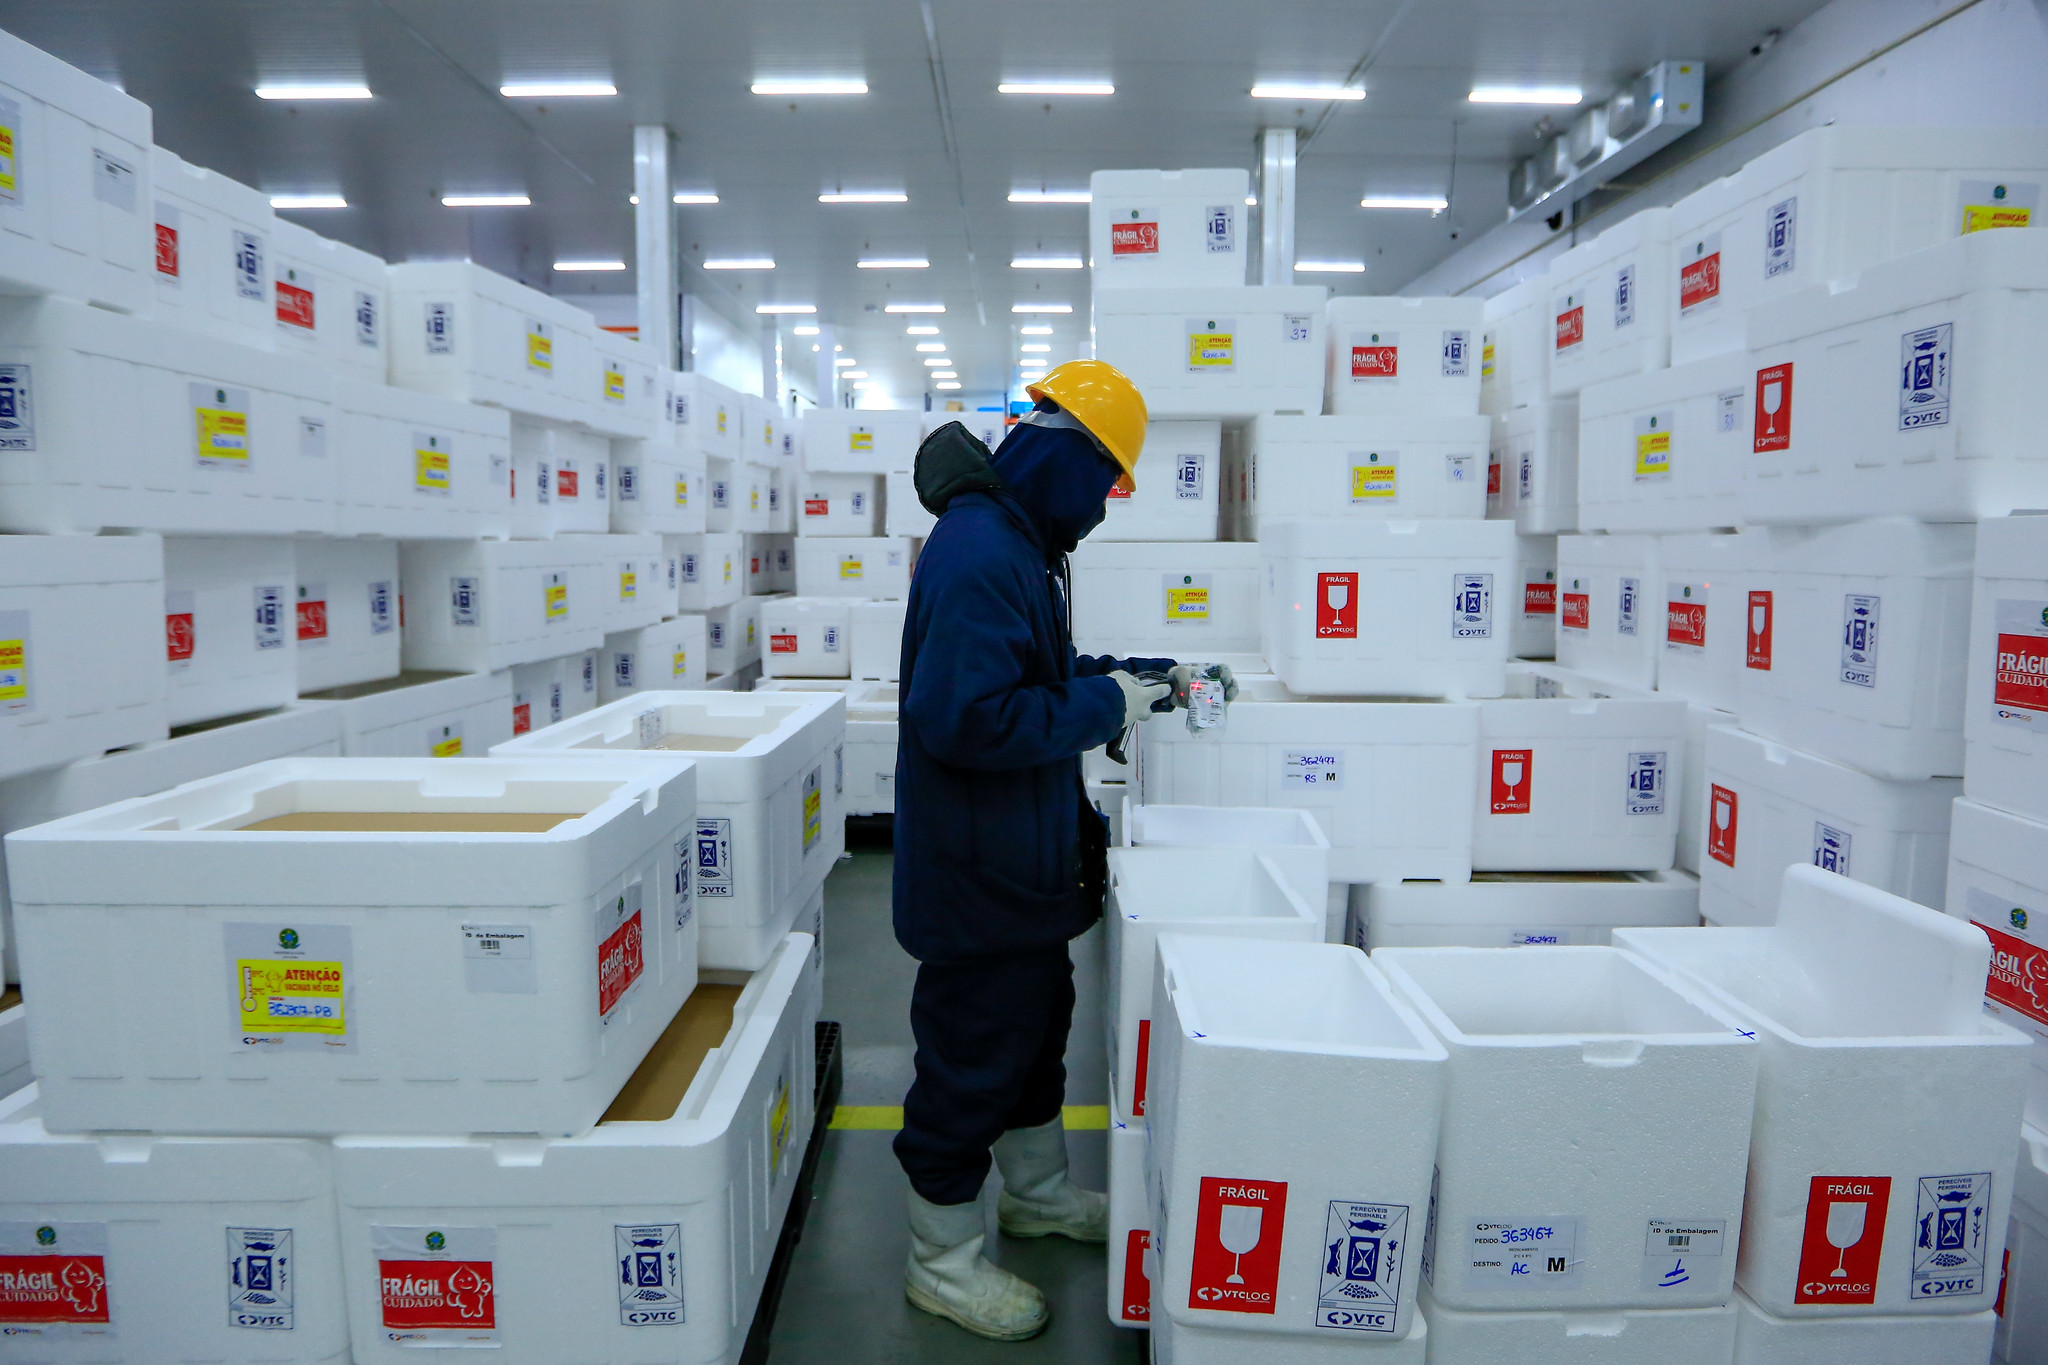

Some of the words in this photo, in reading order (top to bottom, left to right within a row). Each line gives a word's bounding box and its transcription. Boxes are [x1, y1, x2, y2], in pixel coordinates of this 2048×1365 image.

[1113, 229, 1138, 239] FRÁGIL
[1353, 353, 1378, 362] FRÁGIL
[1761, 370, 1785, 382] FRÁGIL
[1920, 411, 1940, 422] VTC
[1668, 611, 1688, 625] FRÁGIL
[1304, 774, 1316, 783] RS
[1326, 773, 1335, 781] M
[285, 967, 341, 984] ATENÇÃO
[1989, 966, 2020, 987] DADO
[1219, 1186, 1269, 1200] FRÁGIL
[1827, 1183, 1874, 1195] FRÁGIL
[1350, 1206, 1388, 1214] PERECÍVEIS
[1350, 1212, 1388, 1220] PERISHABLE
[1501, 1227, 1553, 1245] 363467
[1676, 1228, 1719, 1236] Embalagem
[1511, 1262, 1530, 1275] AC
[1548, 1257, 1566, 1272] M
[382, 1274, 443, 1298] FRÁGIL
[1827, 1284, 1871, 1292] VTCLOG
[1945, 1280, 1974, 1290] VTC
[1223, 1290, 1270, 1300] VTCLOG
[383, 1297, 444, 1308] CUIDADO
[259, 1315, 284, 1325] VTC
[649, 1312, 676, 1321] VTC
[1353, 1313, 1385, 1325] VTC
